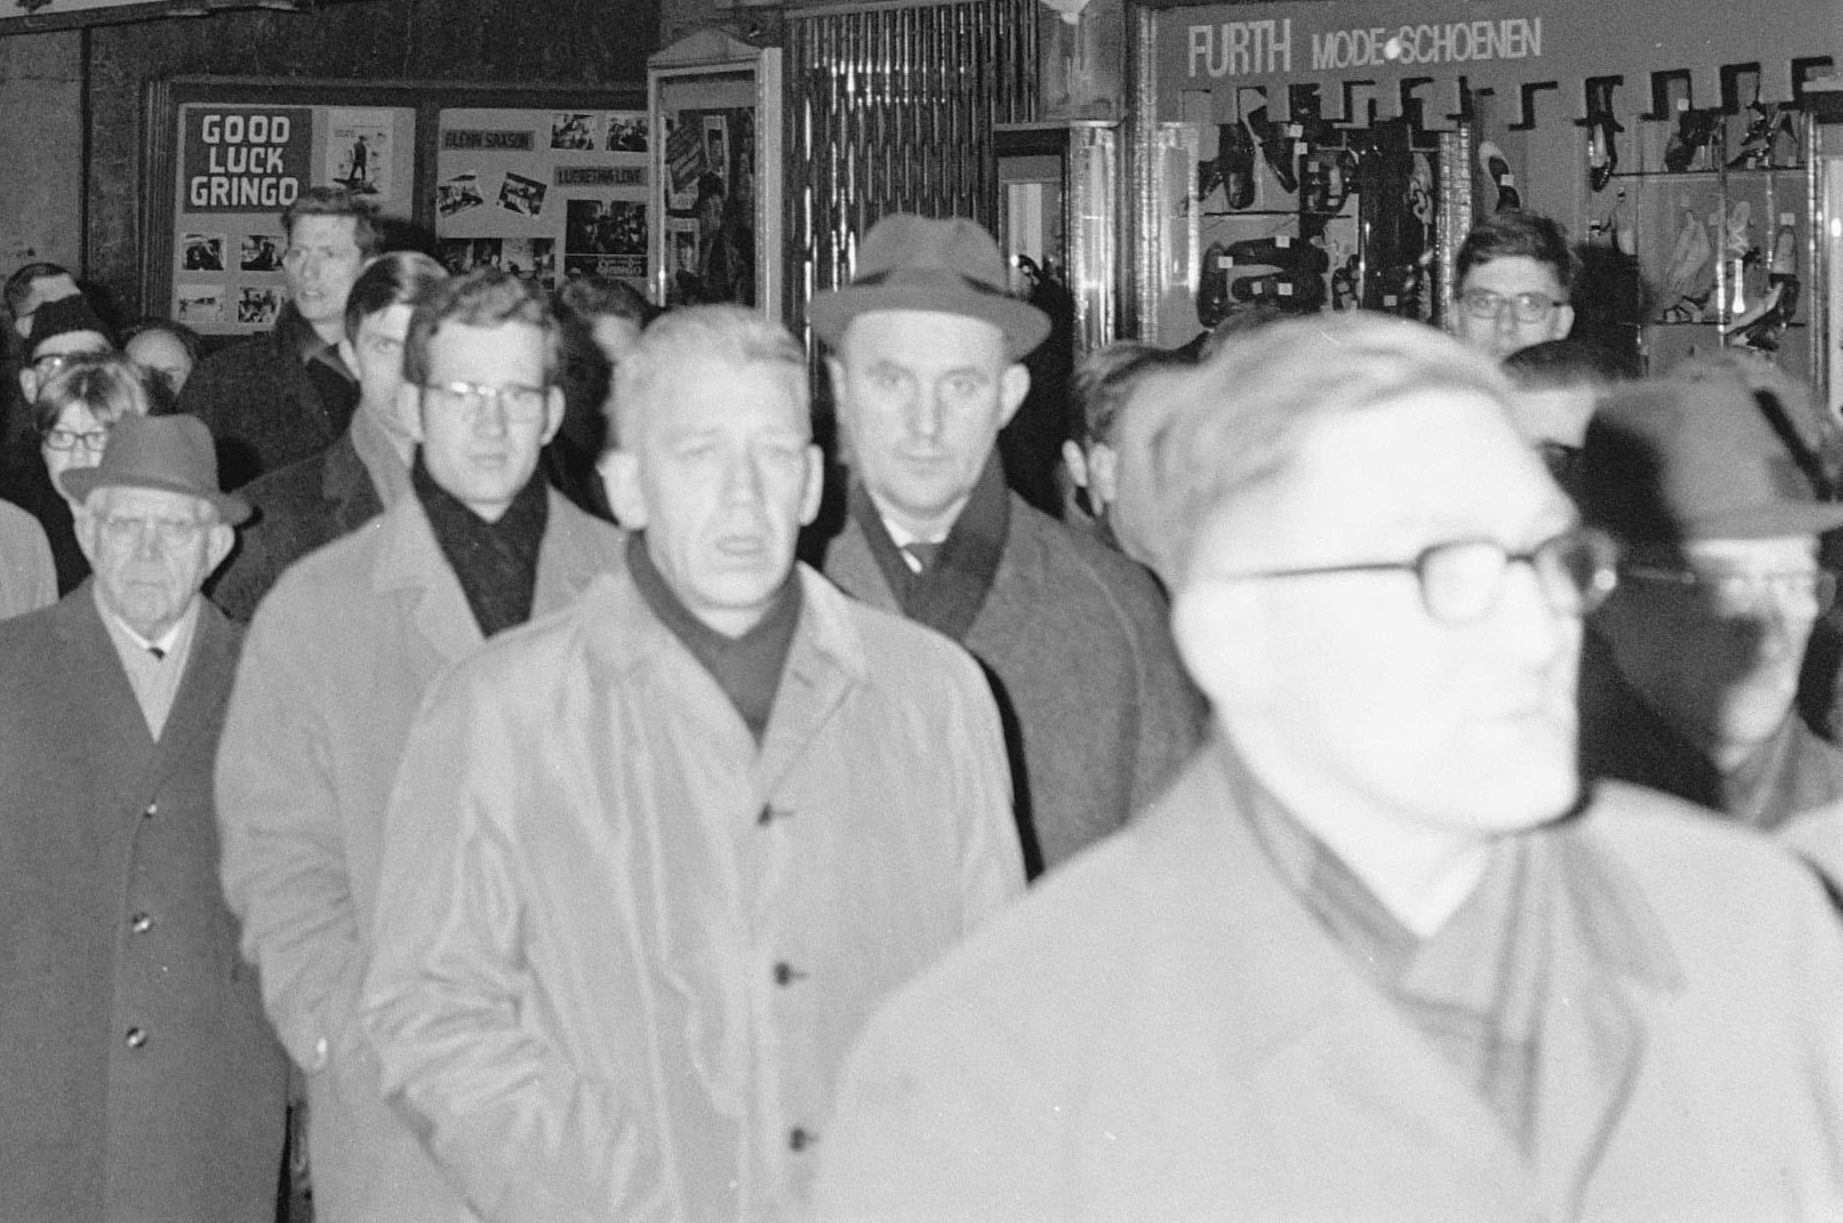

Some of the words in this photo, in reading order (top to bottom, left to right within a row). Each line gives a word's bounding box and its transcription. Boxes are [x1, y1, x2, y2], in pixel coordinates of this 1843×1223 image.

[1188, 18, 1291, 77] FURTH
[202, 115, 290, 144] GOOD
[209, 147, 284, 174] LUCK
[191, 177, 298, 206] GRINGO
